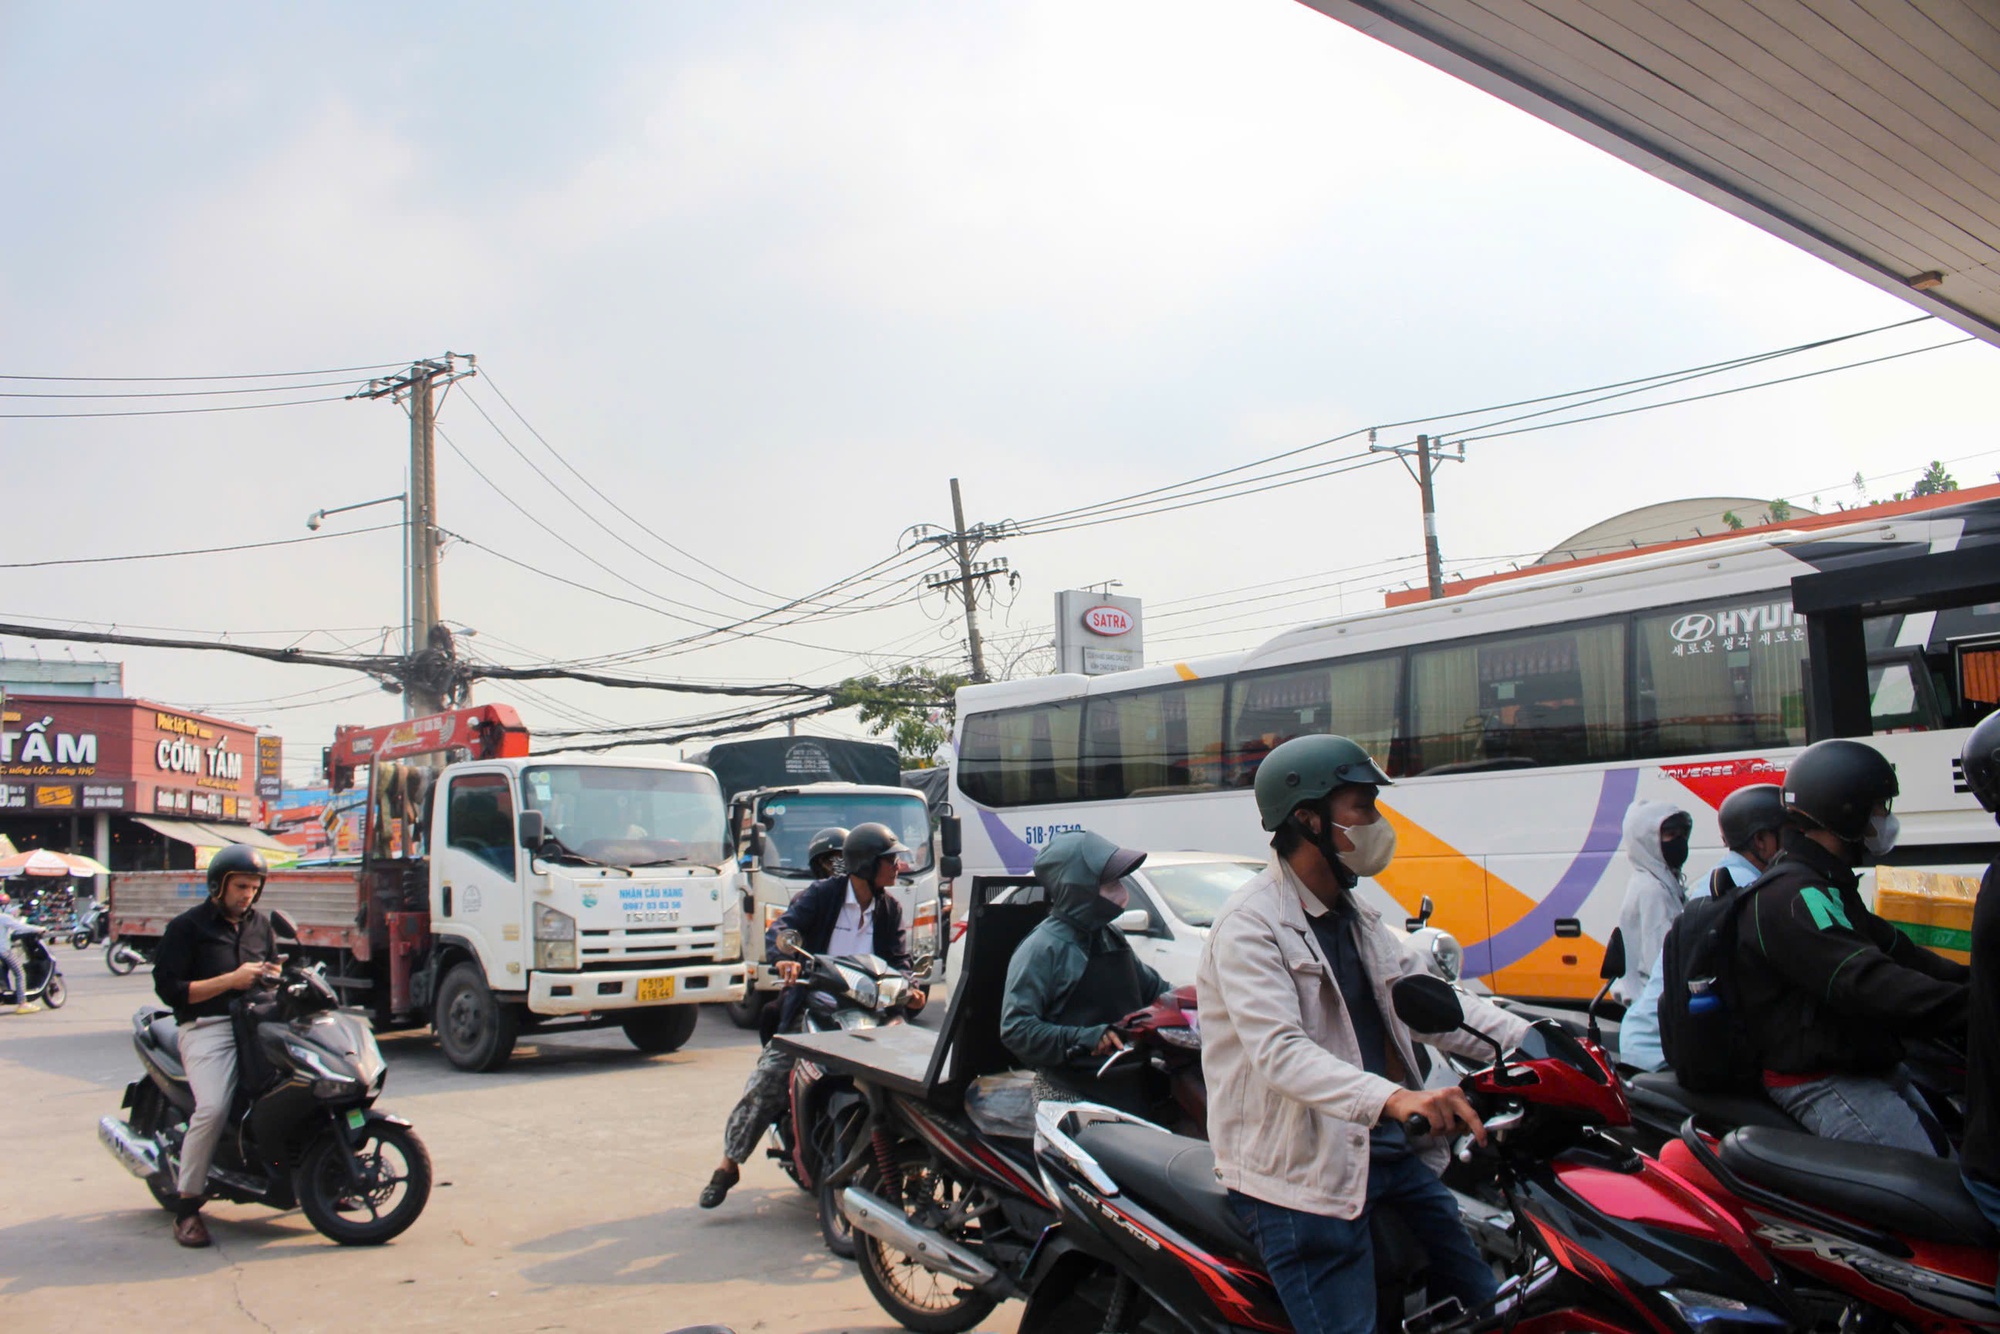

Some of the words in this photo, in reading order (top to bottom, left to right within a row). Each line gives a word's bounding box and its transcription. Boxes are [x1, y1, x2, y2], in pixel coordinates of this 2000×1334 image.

[1093, 612, 1127, 629] SATRA
[1717, 602, 1808, 637] HYUN
[1672, 640, 1715, 657] 새로운
[1722, 634, 1751, 651] 생각
[1758, 628, 1805, 646] 새로운
[1, 716, 97, 764] TẤM
[157, 736, 200, 774] CƠM
[206, 735, 242, 780] TẤM
[1658, 764, 1734, 779] UNIVERSE
[1734, 759, 1792, 775] XPRE
[626, 911, 680, 923] ISUZU
[1101, 1203, 1160, 1251] BLADE
